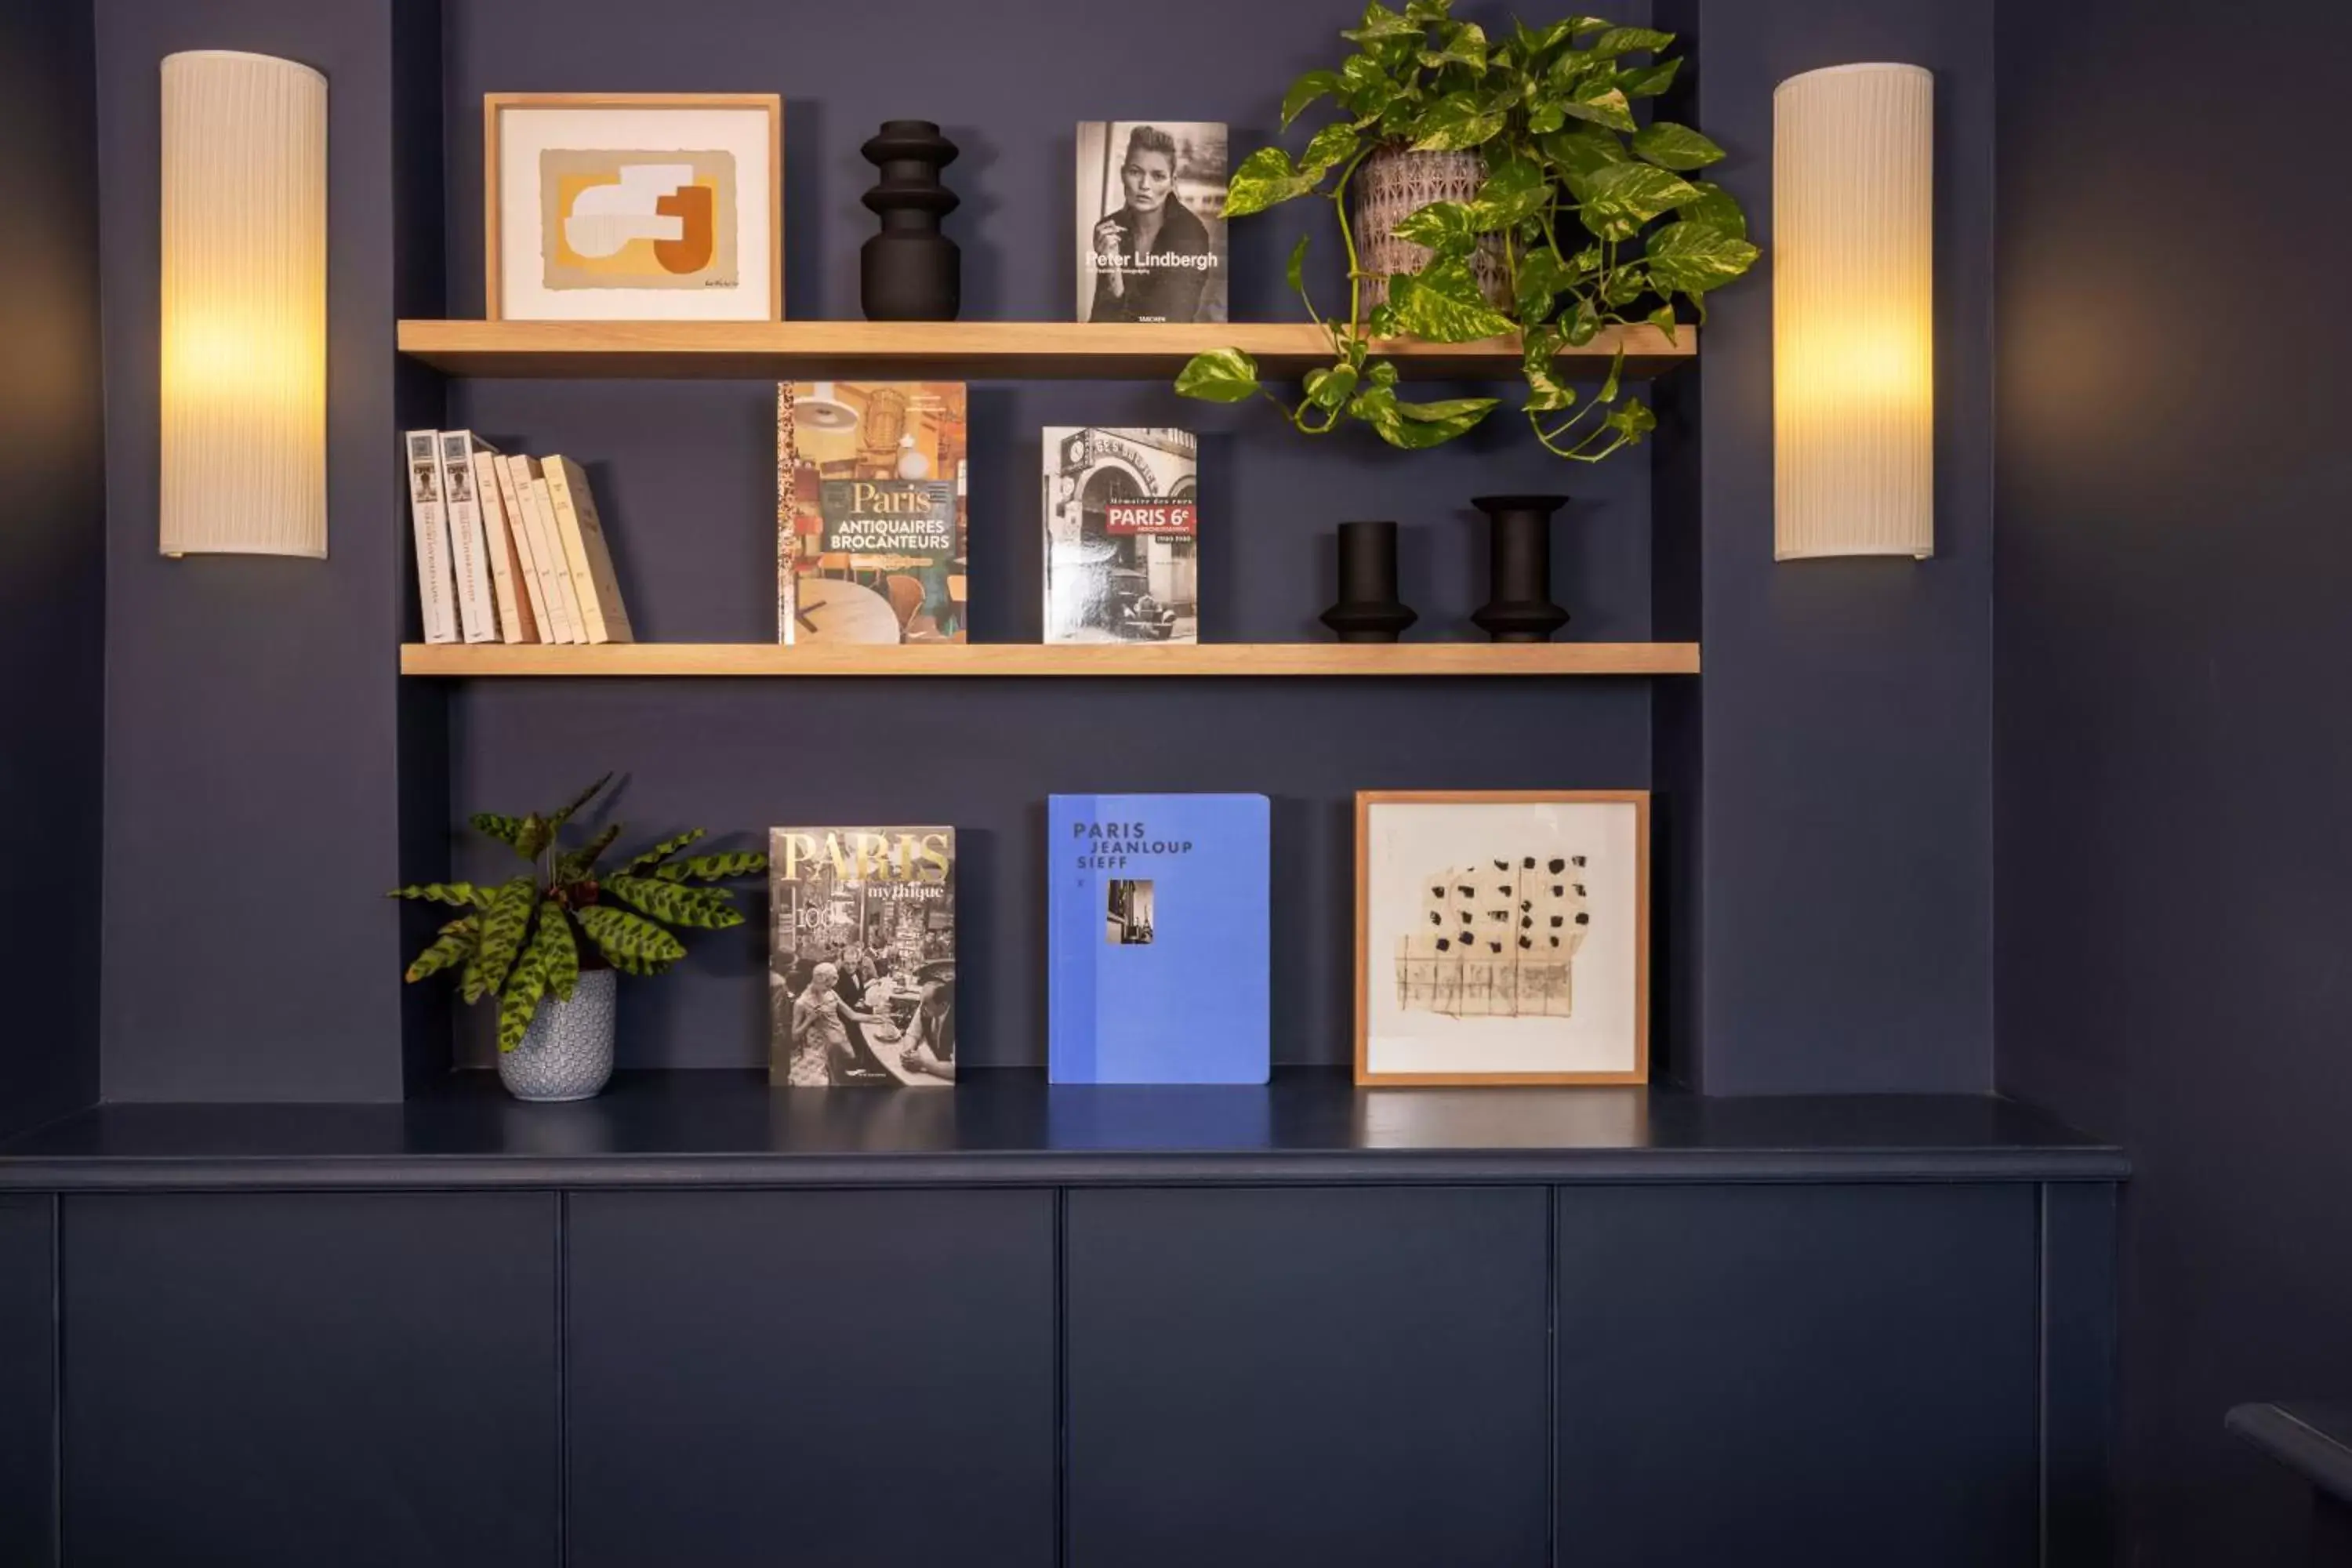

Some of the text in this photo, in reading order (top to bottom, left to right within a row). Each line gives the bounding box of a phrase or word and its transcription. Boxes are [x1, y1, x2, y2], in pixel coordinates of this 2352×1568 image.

[1085, 251, 1218, 270] Peter Lindbergh
[851, 482, 931, 514] Paris
[1109, 509, 1166, 526] PARIS
[838, 520, 945, 536] ANTIQUAIRES
[830, 535, 949, 549] BROCANTEURS
[1073, 822, 1145, 839] PARIS
[1091, 840, 1193, 855] JEANLOUP
[780, 832, 949, 883] PARIS
[1076, 856, 1127, 869] SIEFF
[868, 883, 944, 901] mythique
